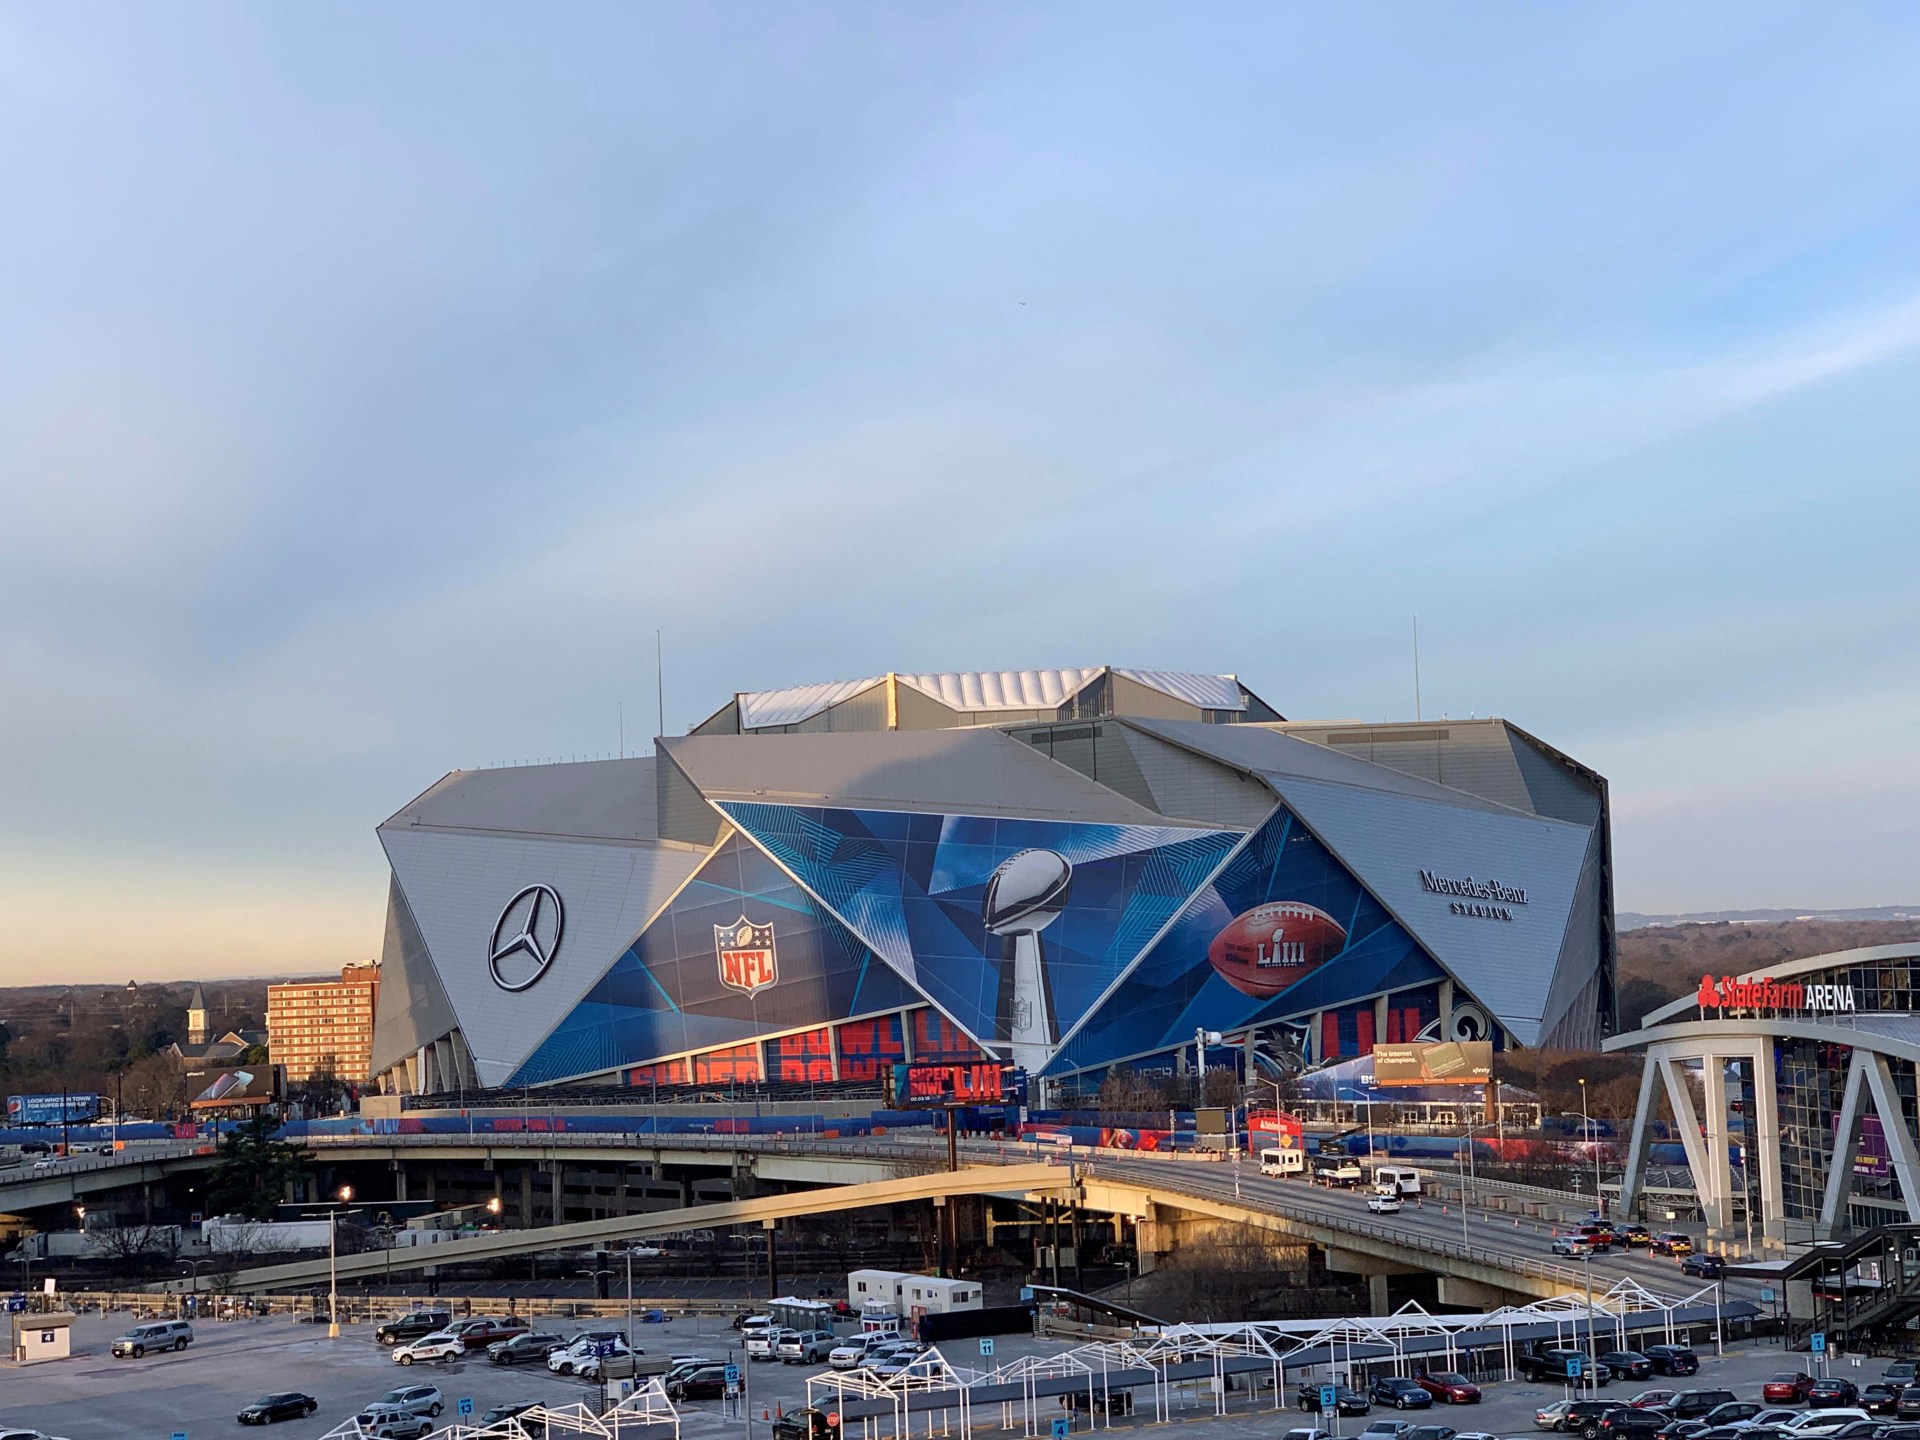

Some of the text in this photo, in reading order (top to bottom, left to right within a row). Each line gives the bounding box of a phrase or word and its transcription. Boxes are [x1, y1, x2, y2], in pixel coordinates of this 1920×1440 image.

[1420, 868, 1530, 904] Mercedes-Benz
[1450, 901, 1514, 921] STADIUM
[723, 952, 773, 988] NFL
[1805, 985, 1855, 1010] ARENA
[983, 1346, 991, 1354] 11
[727, 1370, 738, 1380] 12
[1571, 1365, 1577, 1375] 2
[1325, 1393, 1332, 1403] 3
[461, 1404, 472, 1414] 13
[1057, 1426, 1064, 1435] 4
